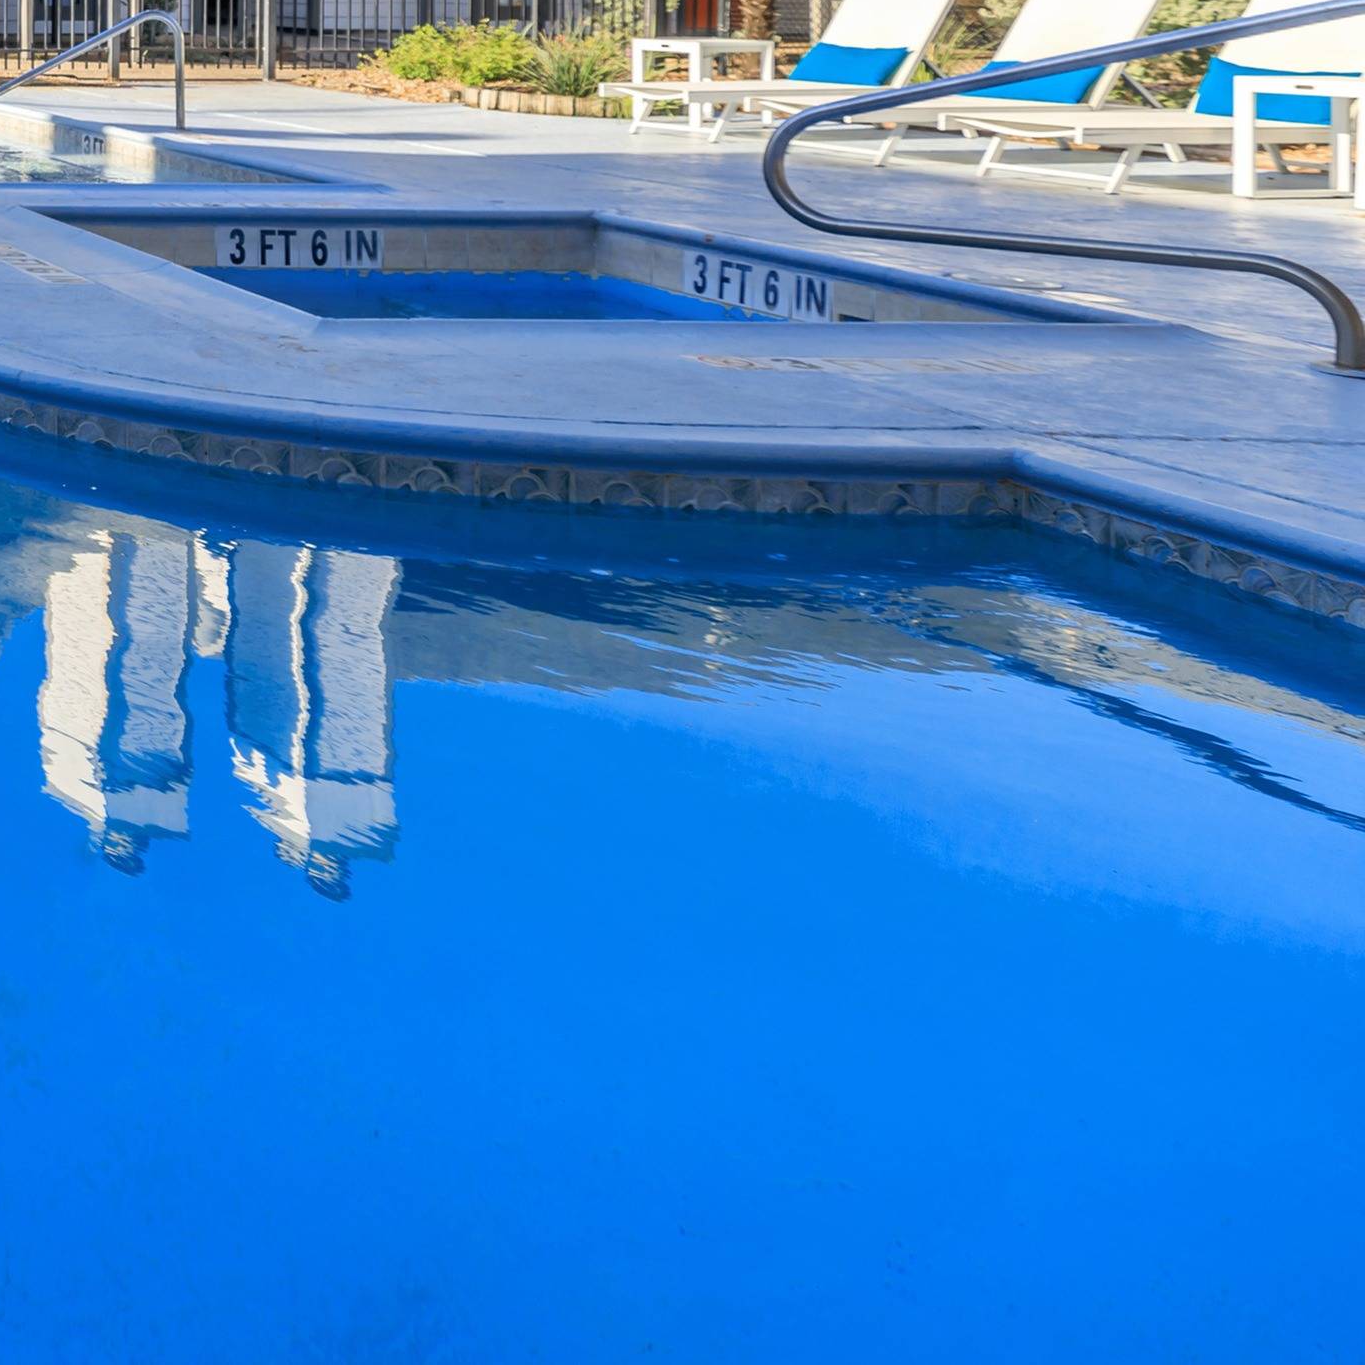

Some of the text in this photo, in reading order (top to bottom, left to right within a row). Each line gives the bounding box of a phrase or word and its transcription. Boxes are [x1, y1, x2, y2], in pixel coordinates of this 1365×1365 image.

[230, 228, 378, 266] 3 FT 6 IN
[694, 255, 827, 317] 3 FT 6 IN
